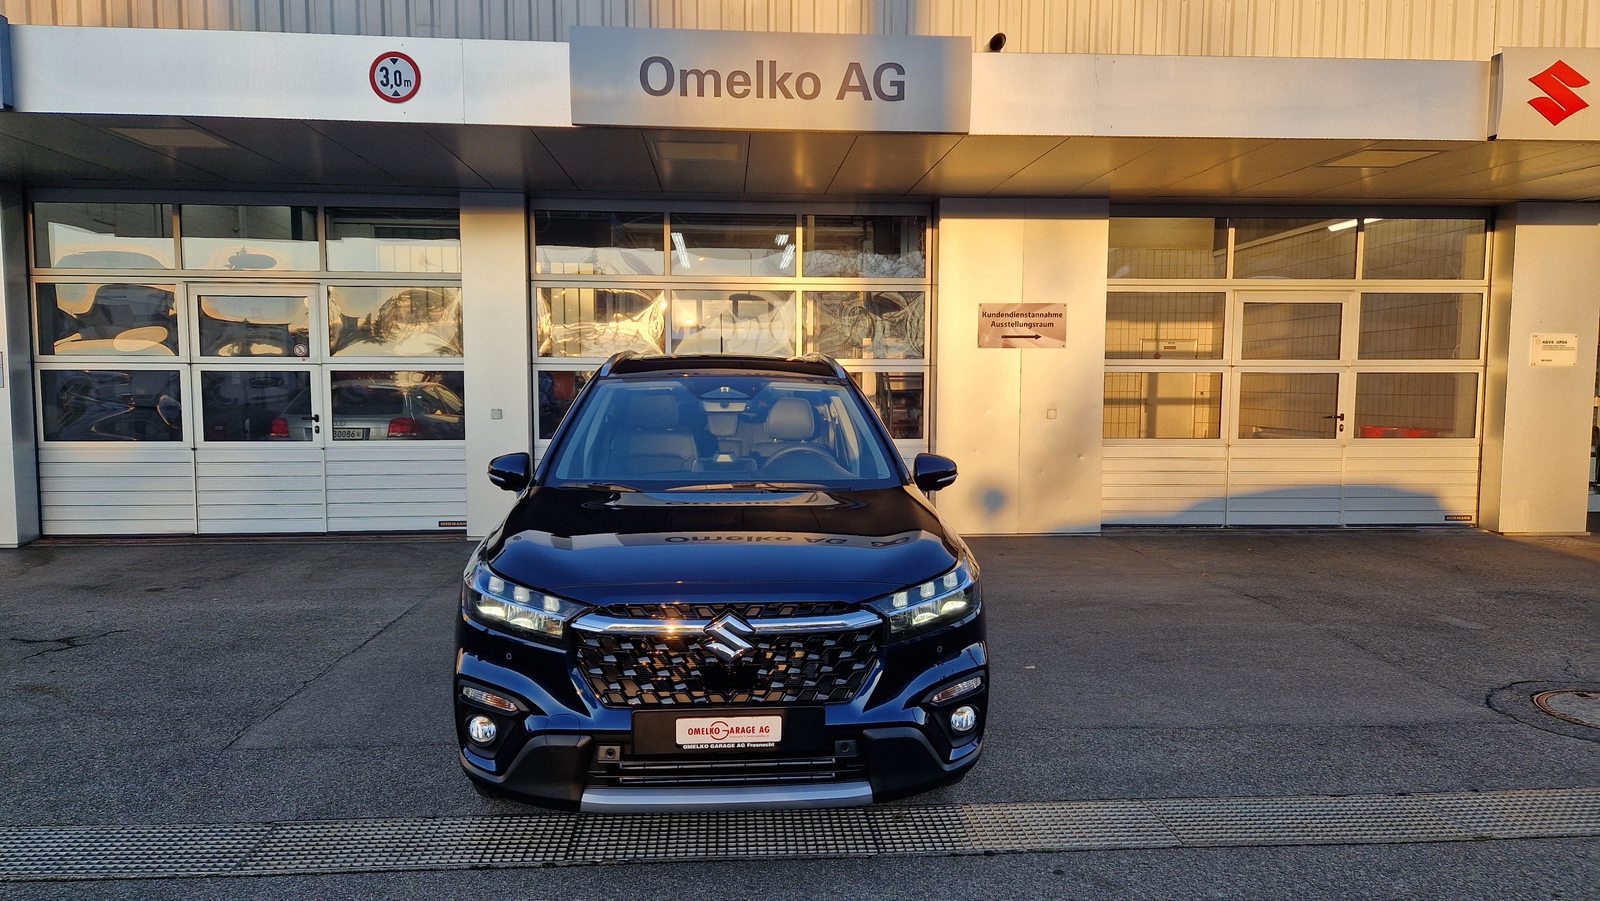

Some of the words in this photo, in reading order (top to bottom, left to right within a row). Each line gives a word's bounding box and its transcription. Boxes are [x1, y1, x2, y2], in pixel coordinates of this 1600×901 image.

[639, 55, 822, 101] Omelko
[835, 62, 906, 102] AG
[990, 320, 1054, 329] Ausstellungsraum
[687, 727, 720, 736] OMELKO
[758, 725, 770, 734] AG
